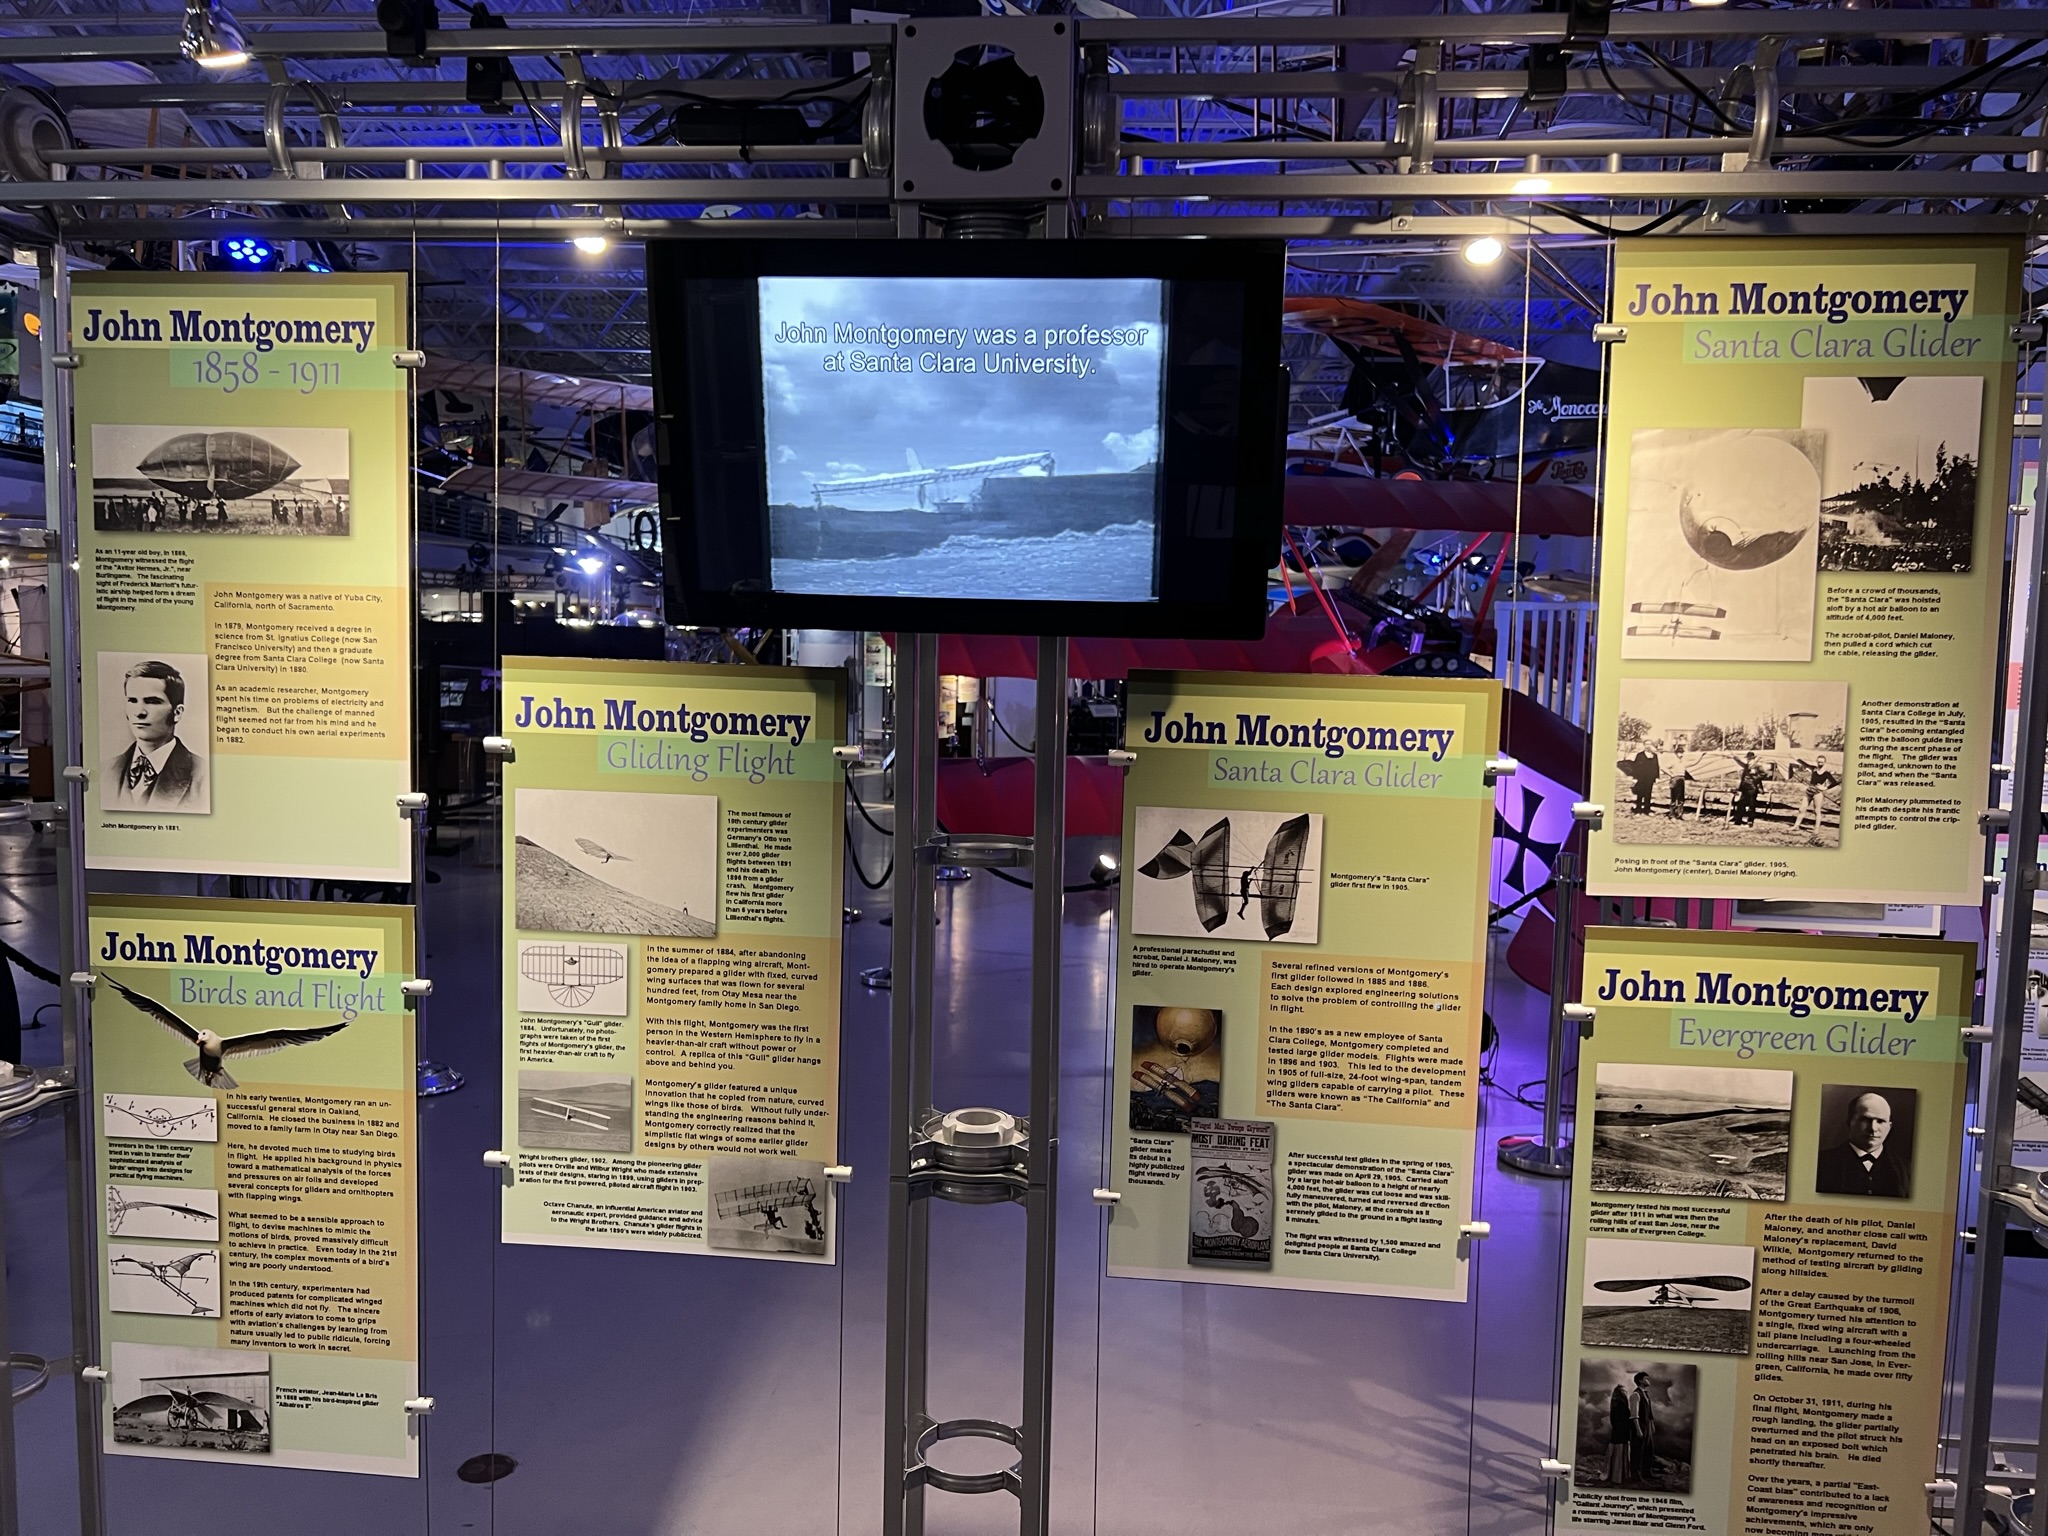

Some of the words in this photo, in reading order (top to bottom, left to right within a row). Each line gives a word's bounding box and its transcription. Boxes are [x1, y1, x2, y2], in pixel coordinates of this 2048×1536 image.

[1628, 284, 1718, 316] John
[1728, 283, 1968, 322] Montgomery
[83, 309, 162, 341] John
[170, 311, 374, 353] Montgomery
[775, 322, 827, 344] John
[834, 322, 967, 349] Montgomery
[974, 327, 1017, 345] was
[1025, 327, 1037, 345] a
[1045, 324, 1148, 349] professor
[1694, 329, 1780, 359] Santa
[1790, 324, 1874, 358] Clara
[1883, 322, 1981, 357] Glider
[193, 351, 260, 393] 1858
[288, 361, 340, 394] 1911
[824, 354, 844, 372] at
[850, 351, 912, 373] Santa
[919, 351, 976, 373] Clara
[984, 353, 1096, 378] University.
[235, 590, 284, 601] Montgomery
[343, 593, 364, 601] Yuba
[515, 696, 595, 729] John
[604, 699, 810, 746] Montgomery
[1144, 712, 1226, 745] John
[1236, 715, 1454, 762] Montgomery
[607, 738, 709, 782] Gliding
[718, 743, 796, 784] Flight
[1214, 758, 1282, 783] Santa
[1290, 758, 1355, 786] Clara
[1365, 761, 1443, 789] Glider
[1614, 857, 1640, 866] Posing
[101, 932, 176, 962] John
[184, 935, 378, 979] Montgomery
[646, 944, 654, 952] In
[738, 948, 756, 957] after
[758, 950, 806, 961] abandoning
[1271, 961, 1302, 970] Several
[1305, 963, 1334, 972] refined
[1337, 965, 1373, 974] versions
[1271, 971, 1288, 980] first
[1290, 973, 1315, 982] glider
[1316, 974, 1353, 984] followed
[1356, 976, 1364, 984] in
[1367, 977, 1386, 986] 1885
[180, 976, 246, 1005] Birds
[255, 979, 303, 1008] and
[312, 980, 385, 1020] Flight
[1598, 969, 1685, 1003] John
[1695, 972, 1929, 1022] Montgomery
[645, 1016, 664, 1025] With
[666, 1018, 681, 1026] this
[708, 1019, 759, 1032] Montgomery
[792, 1024, 809, 1032] first
[1679, 1018, 1817, 1059] Evergreen
[1827, 1021, 1916, 1056] Glider
[248, 1094, 267, 1103] early
[304, 1096, 352, 1107] Montgomery
[1192, 1133, 1213, 1144] MOST
[1217, 1135, 1246, 1147] DARING
[1250, 1138, 1270, 1149] FEAT
[1590, 1200, 1635, 1210] Montgomery
[339, 1218, 375, 1226] approach
[1764, 1212, 1787, 1221] After
[1788, 1214, 1803, 1222] the
[1805, 1215, 1830, 1224] death
[1832, 1216, 1843, 1225] of
[1844, 1217, 1858, 1226] his
[1886, 1220, 1915, 1229] Daniel
[1752, 1393, 1766, 1402] On
[1768, 1394, 1804, 1404] October
[1846, 1400, 1876, 1411] during
[1878, 1402, 1892, 1410] his
